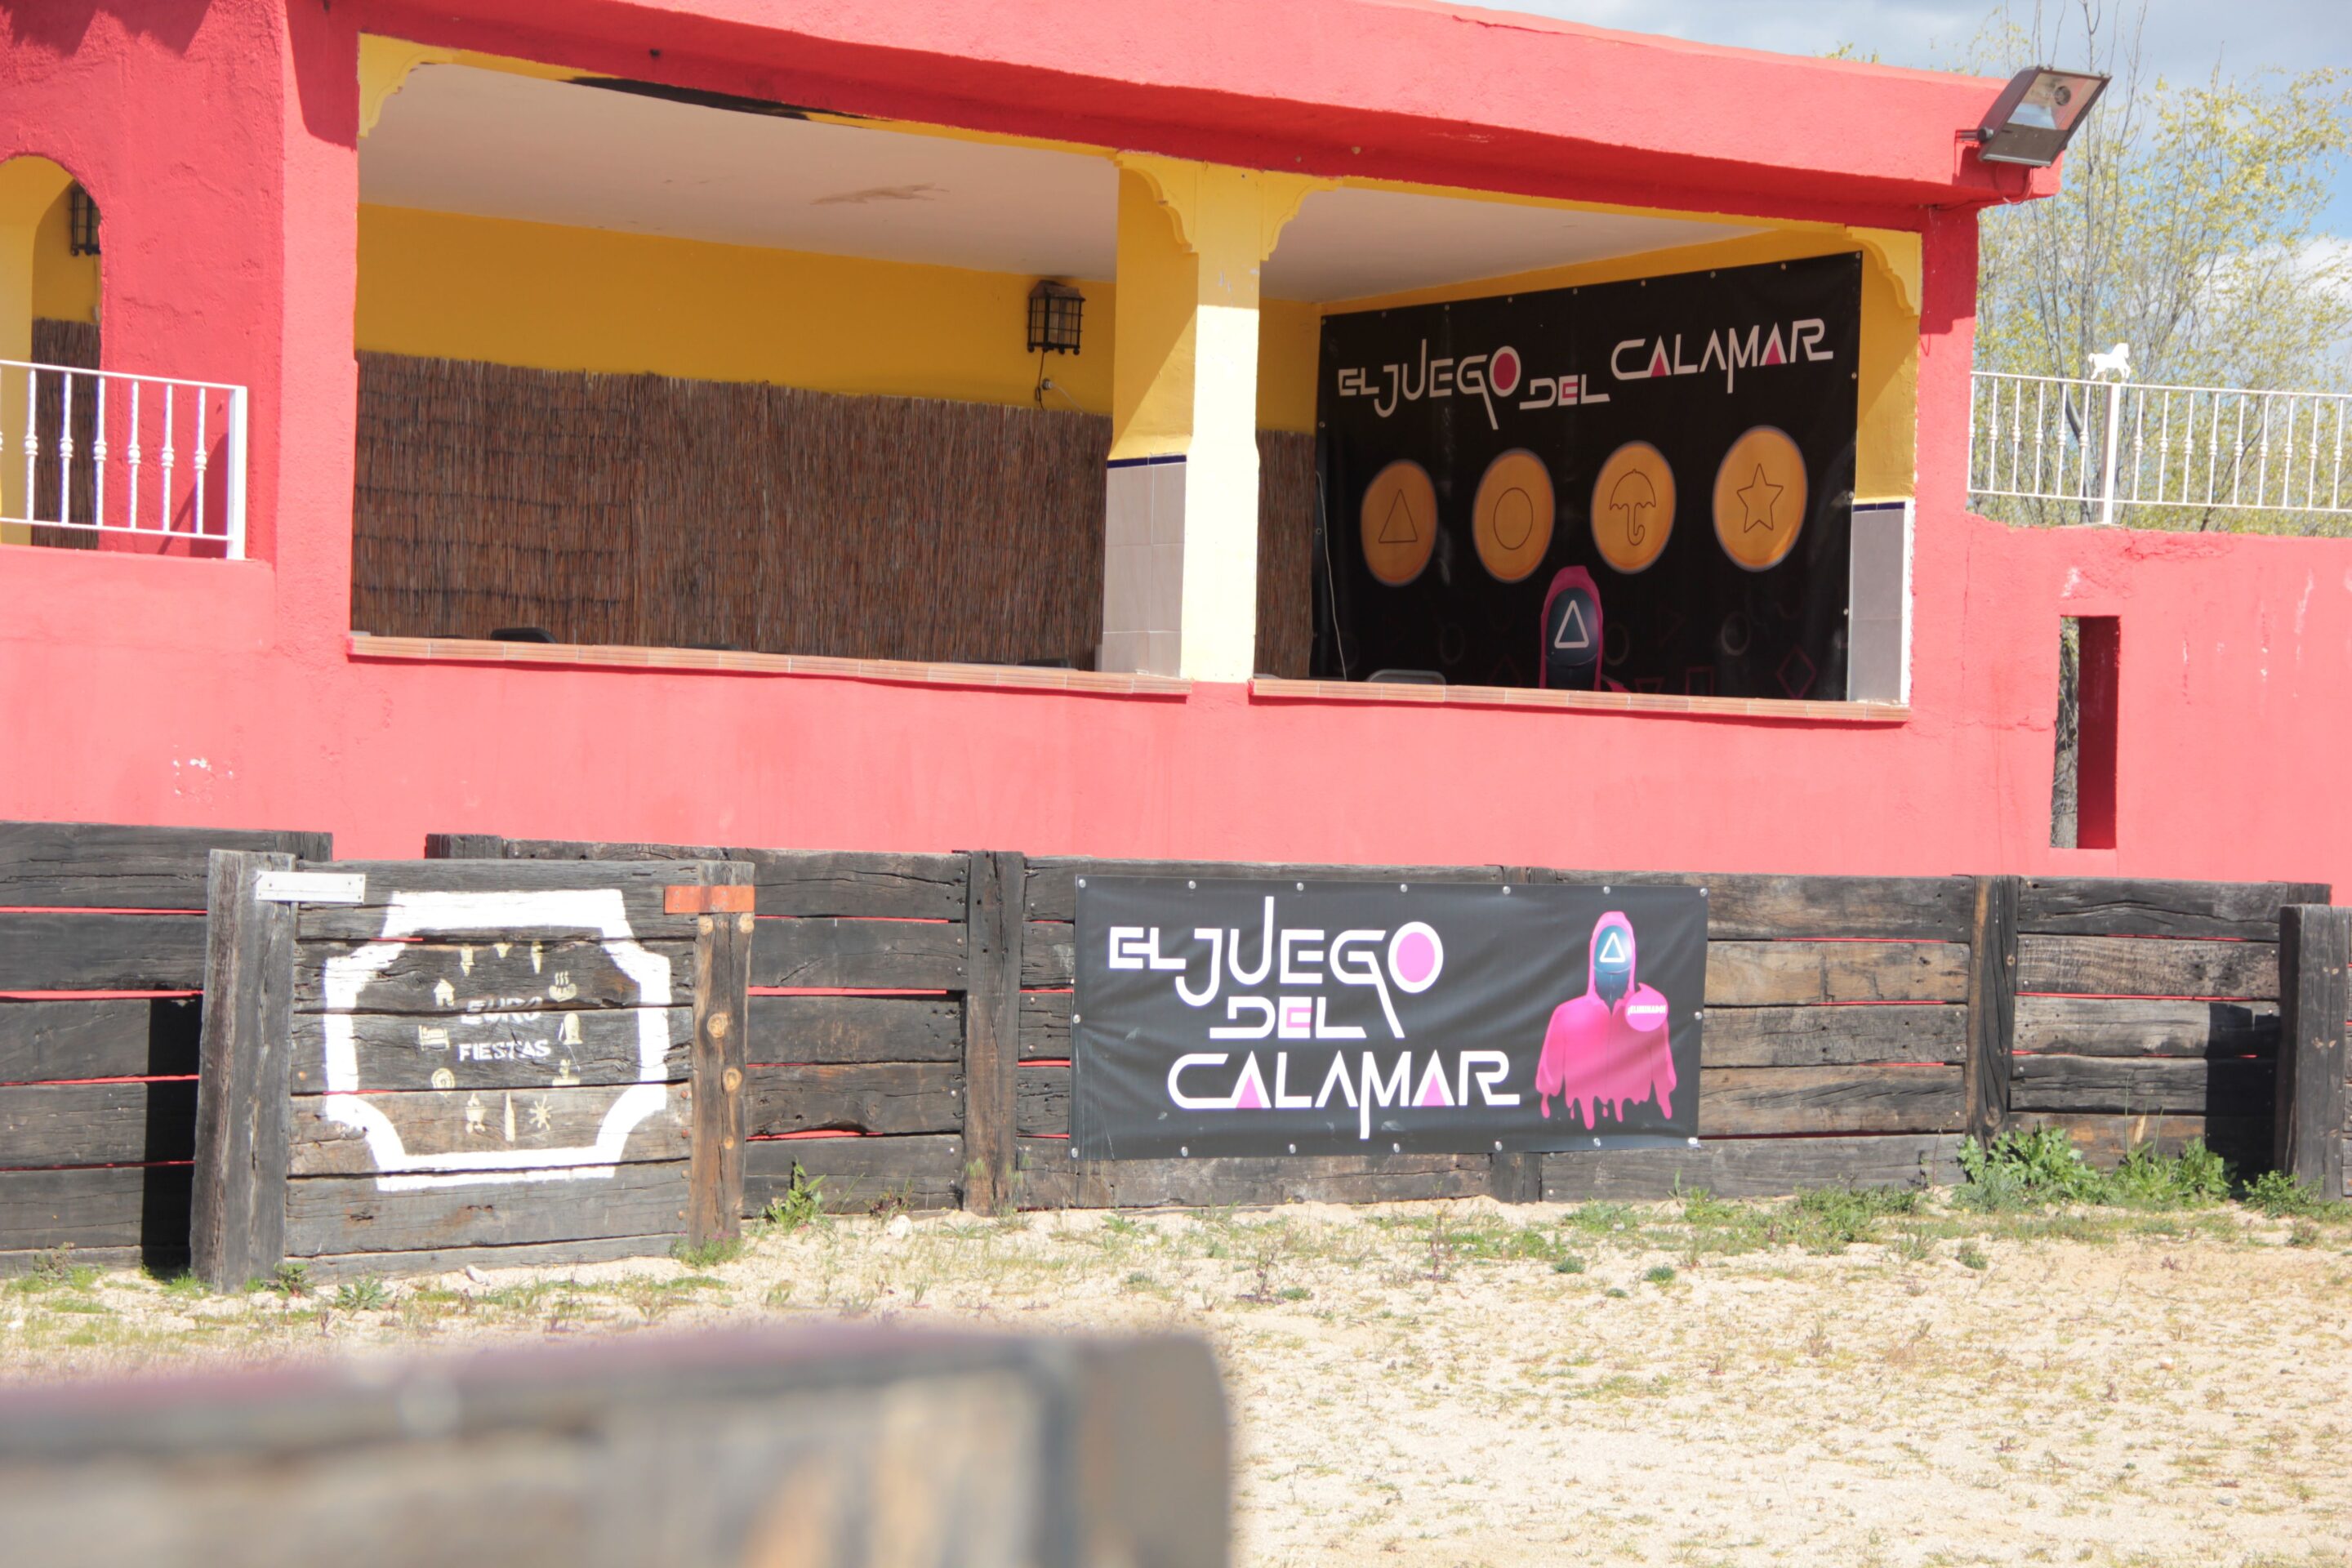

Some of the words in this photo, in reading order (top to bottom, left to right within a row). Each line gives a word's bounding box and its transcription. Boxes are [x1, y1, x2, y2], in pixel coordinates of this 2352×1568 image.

[1338, 368, 1379, 397] EL
[1374, 339, 1521, 430] JUEGO
[1519, 374, 1610, 410] DEL
[1610, 318, 1833, 394] CALAMAR
[1108, 927, 1187, 969] EL
[1174, 896, 1444, 1039] JUEGO
[461, 996, 543, 1025] EURO
[1209, 996, 1366, 1039] DEL
[459, 1039, 551, 1062] FIESTAS
[1167, 1049, 1521, 1139] CALAMAR
